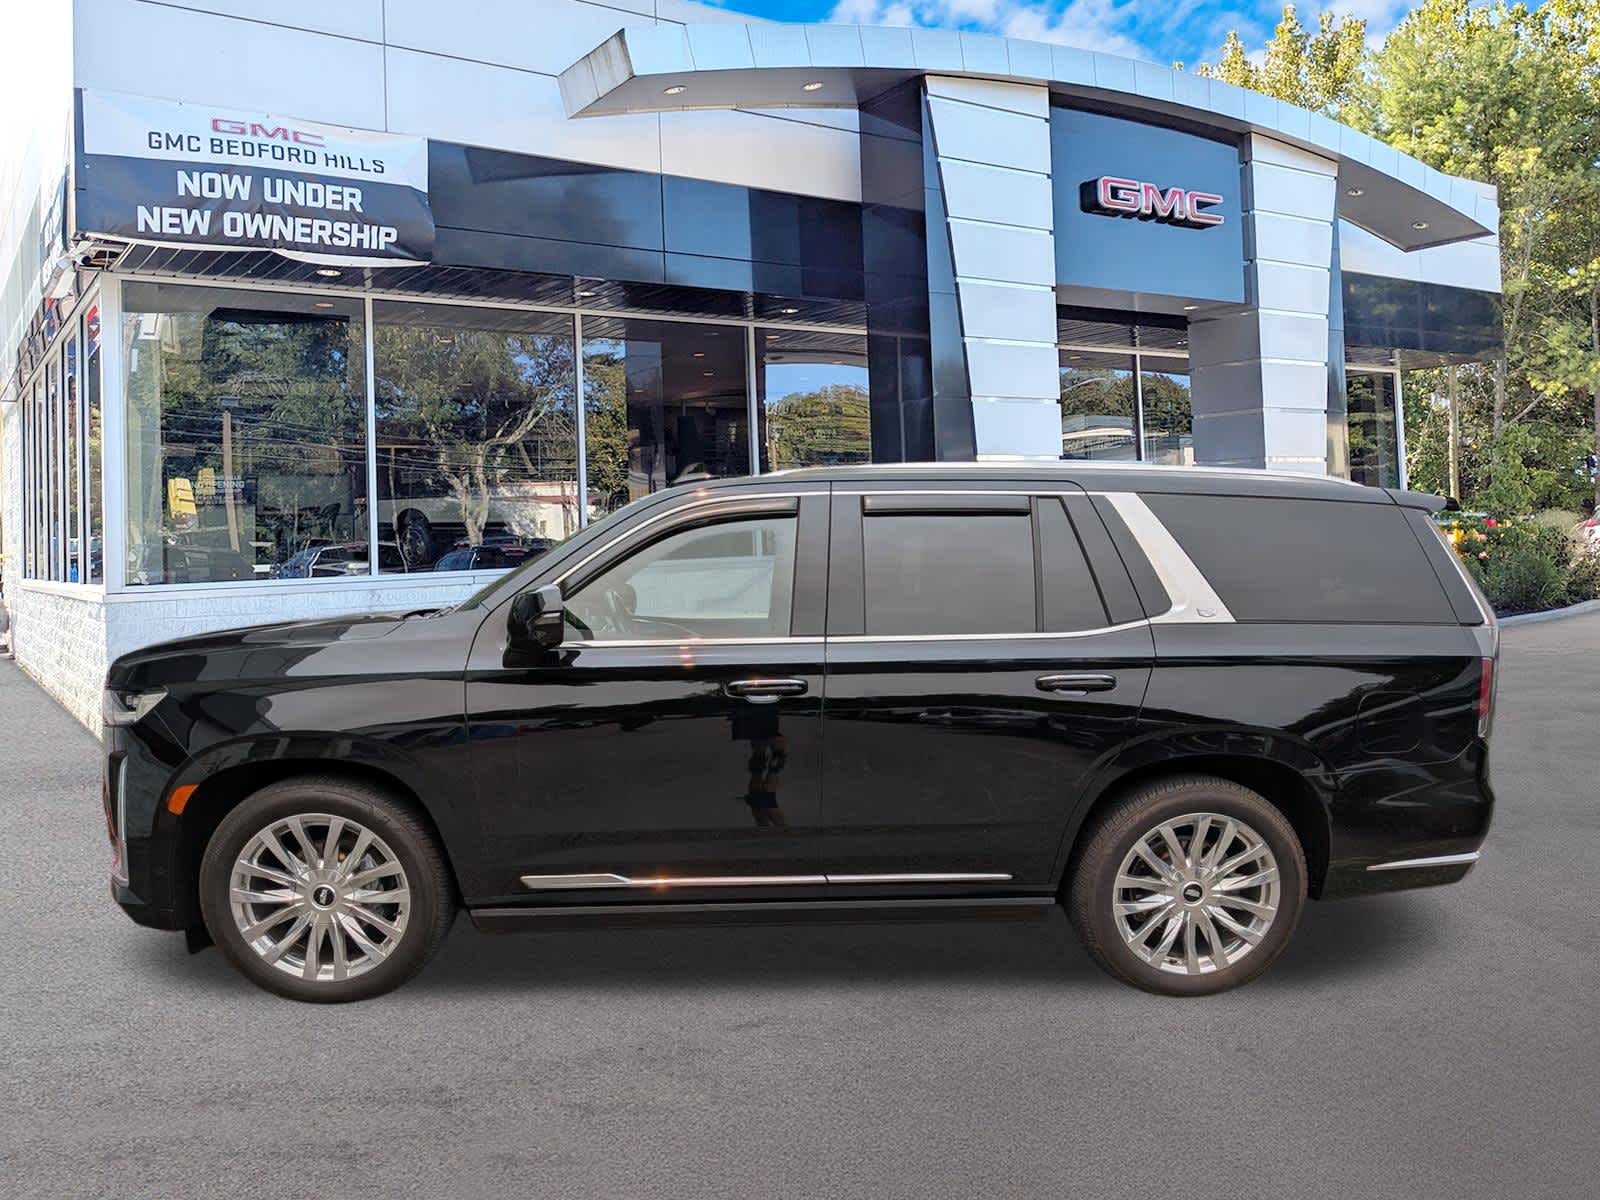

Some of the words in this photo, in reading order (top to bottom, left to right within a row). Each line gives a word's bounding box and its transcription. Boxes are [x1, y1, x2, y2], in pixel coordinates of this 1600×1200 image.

[148, 131, 201, 152] GMC
[210, 138, 317, 165] BEDFORD
[325, 153, 385, 174] HILLS
[211, 118, 326, 148] GMC
[177, 170, 252, 201] NOW
[263, 177, 364, 213] UNDER
[1096, 175, 1225, 225] GMC
[137, 205, 213, 236] NEW
[223, 211, 398, 250] OWNERSHIP
